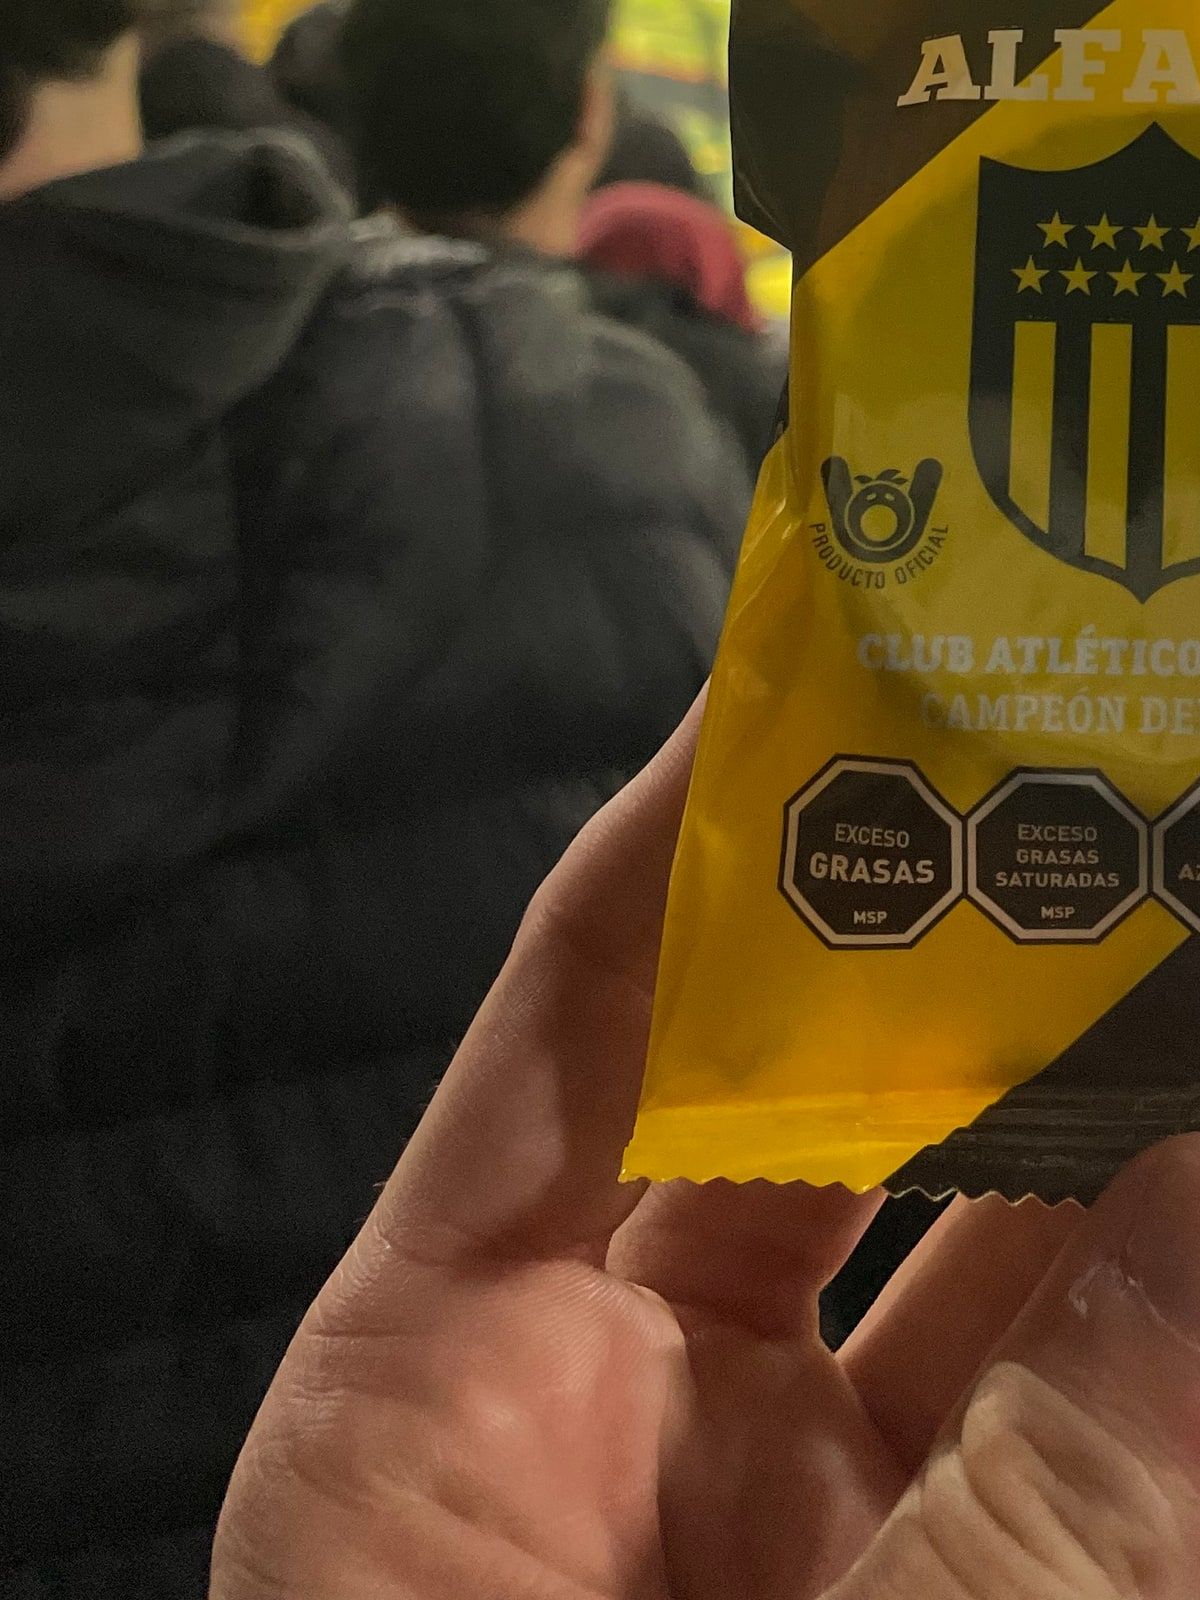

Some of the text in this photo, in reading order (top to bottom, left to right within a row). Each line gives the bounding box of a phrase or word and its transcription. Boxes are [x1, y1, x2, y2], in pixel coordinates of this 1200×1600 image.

[809, 523, 949, 589] PRODUCTO OFICIAL
[857, 633, 976, 674] CLUB
[923, 690, 1126, 734] CAMPEÓN
[834, 823, 910, 849] EXCESO
[1017, 824, 1098, 842] EXCESO
[1016, 847, 1100, 865] GRASAS
[809, 852, 936, 886] GRASAS
[995, 871, 1120, 889] SATURADAS
[853, 910, 888, 925] MSP
[1040, 906, 1075, 920] MSP
